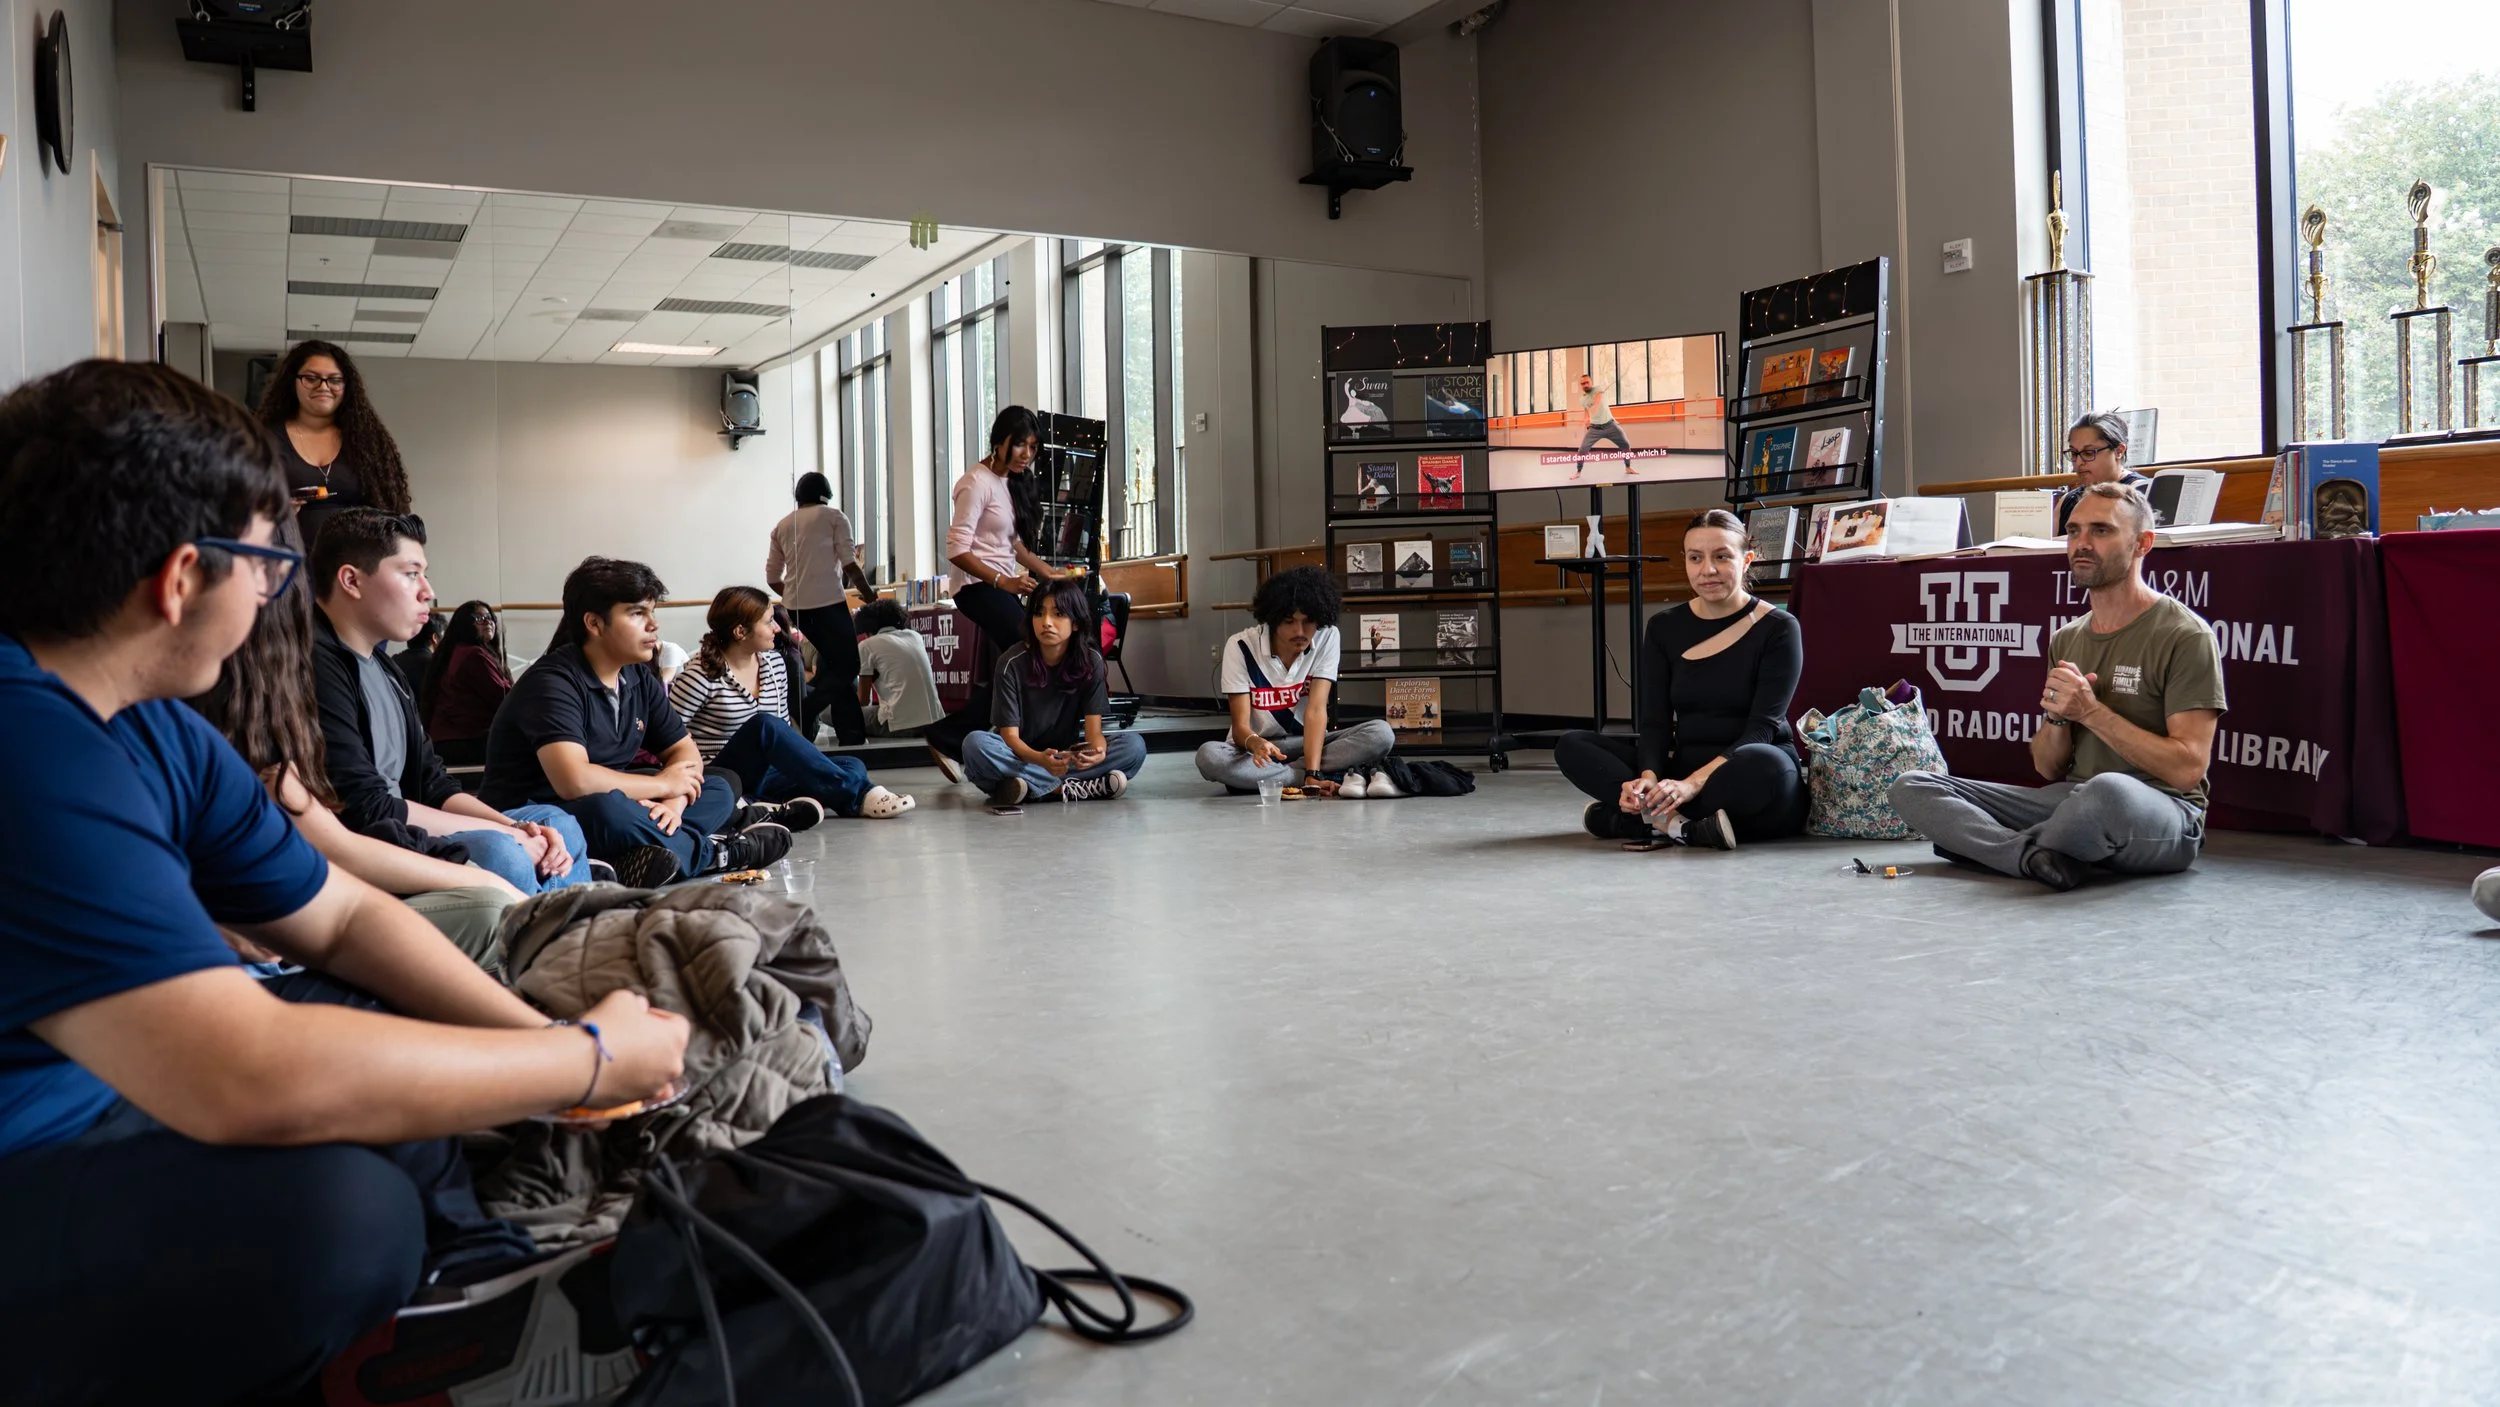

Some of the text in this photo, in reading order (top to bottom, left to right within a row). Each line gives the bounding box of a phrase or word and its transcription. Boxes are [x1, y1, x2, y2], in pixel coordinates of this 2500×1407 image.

[1355, 377, 1388, 391] Swan
[1444, 388, 1482, 398] DANCE
[1546, 455, 1571, 463] started
[1572, 453, 1600, 462] dancing
[1601, 452, 1608, 460] in
[1610, 450, 1636, 460] college,
[1638, 448, 1659, 457] which
[1660, 448, 1667, 456] is
[1367, 464, 1395, 473] Staging
[1913, 628, 2016, 642] THE INTERNATIONAL
[1947, 708, 2042, 743] RADCLI
